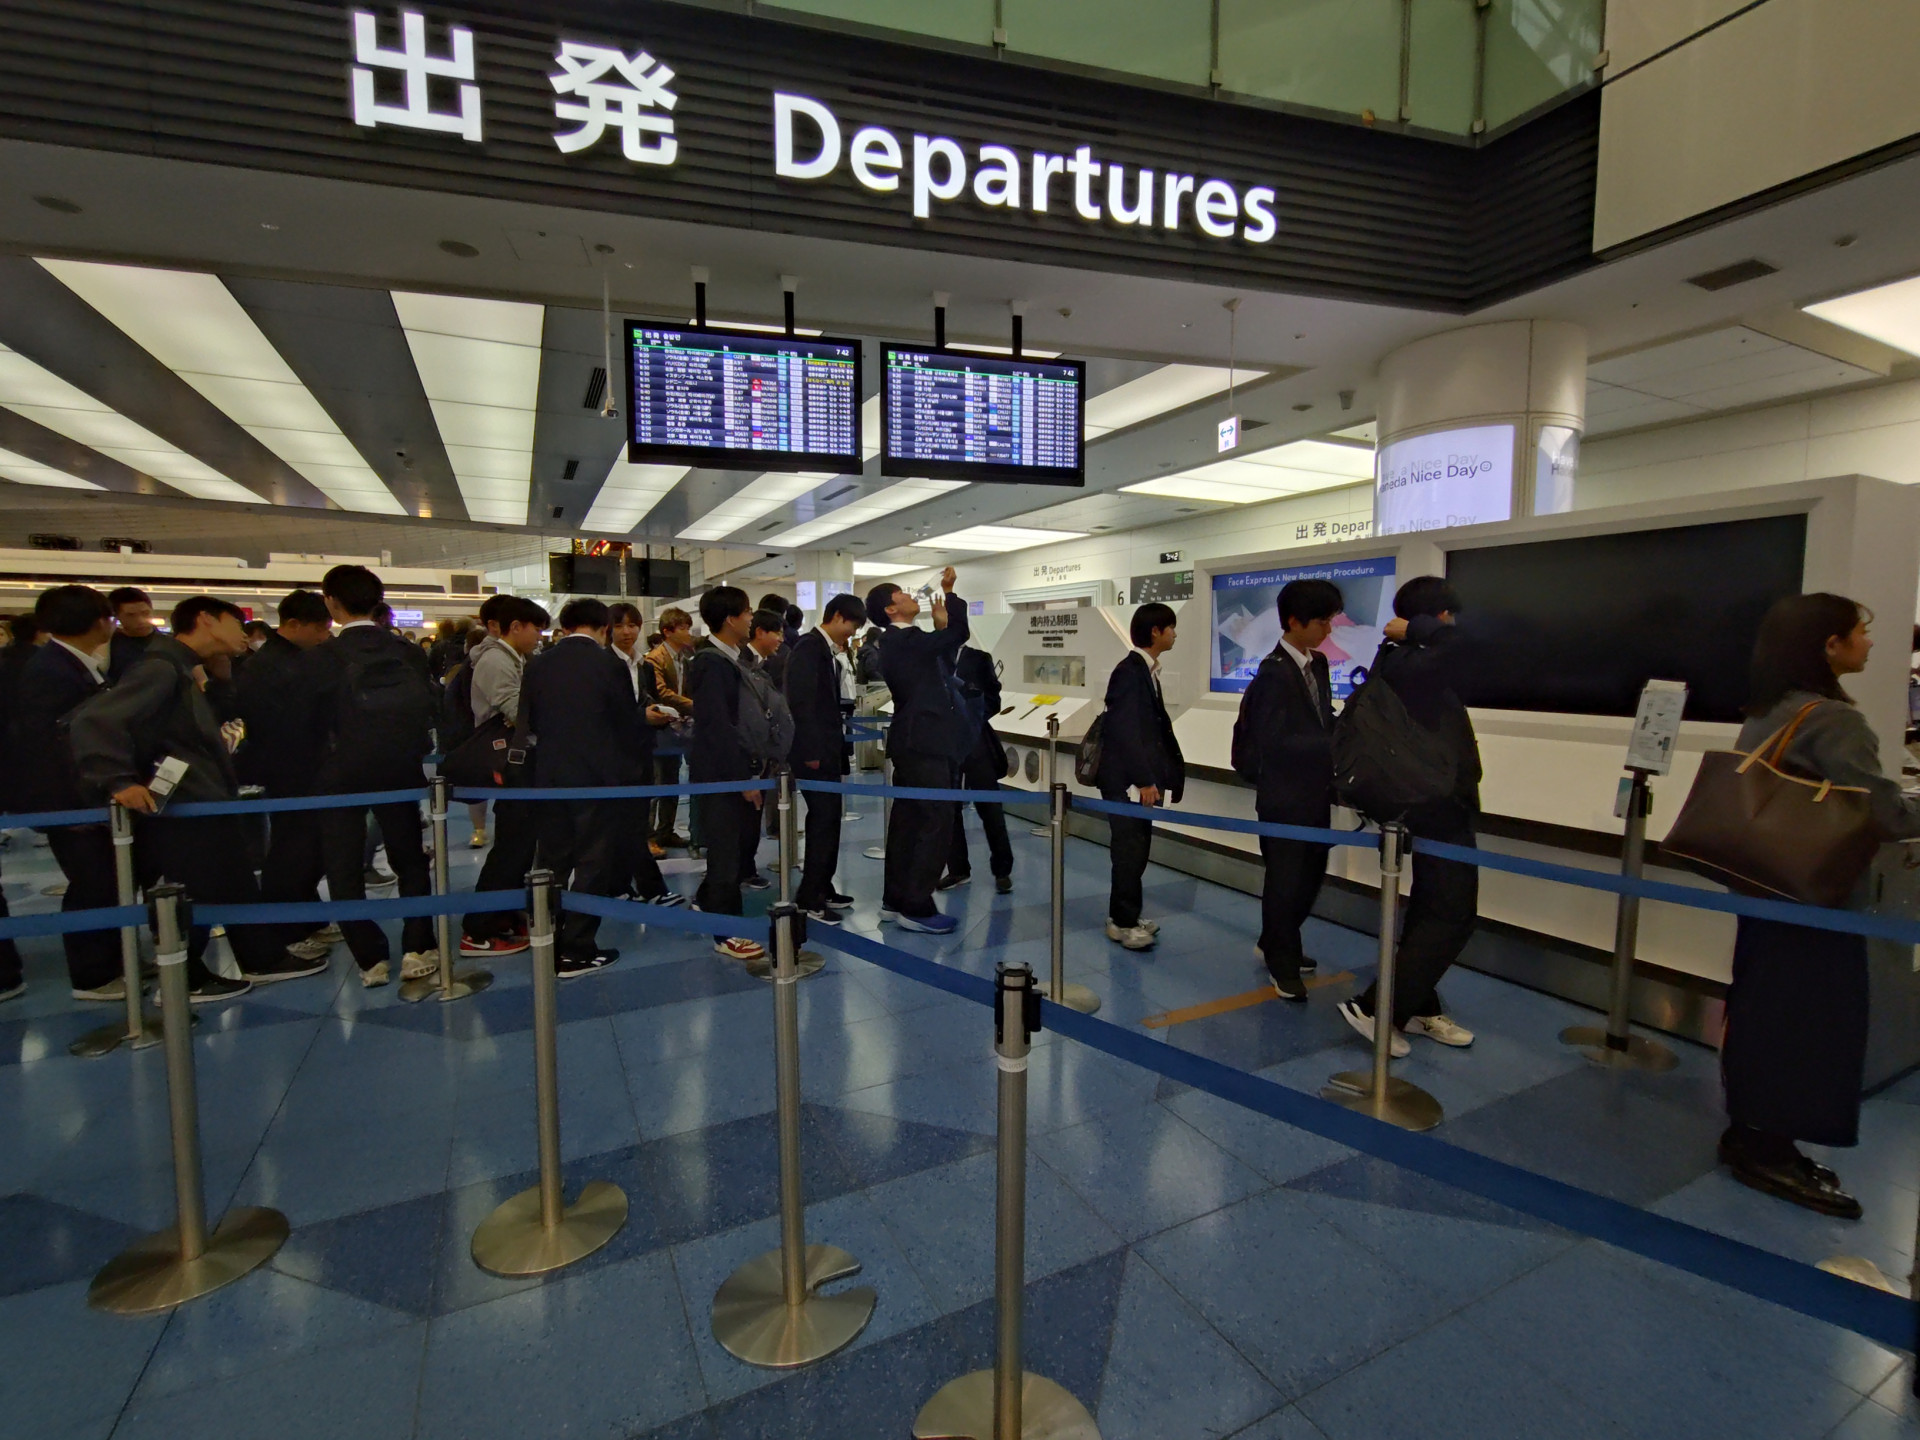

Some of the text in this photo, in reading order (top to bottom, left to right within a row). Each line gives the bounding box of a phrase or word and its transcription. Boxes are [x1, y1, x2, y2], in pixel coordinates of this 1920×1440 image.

[774, 93, 1276, 243] Departures
[1410, 470, 1442, 485] Nice
[1447, 464, 1479, 479] Day
[1331, 519, 1374, 536] Depar
[1049, 563, 1081, 576] Departures
[1228, 577, 1244, 587] Face
[1245, 575, 1274, 586] Express
[1282, 573, 1297, 581] New
[1298, 570, 1332, 581] Boarding
[1333, 566, 1375, 577] Procedure
[1117, 591, 1124, 606] 6
